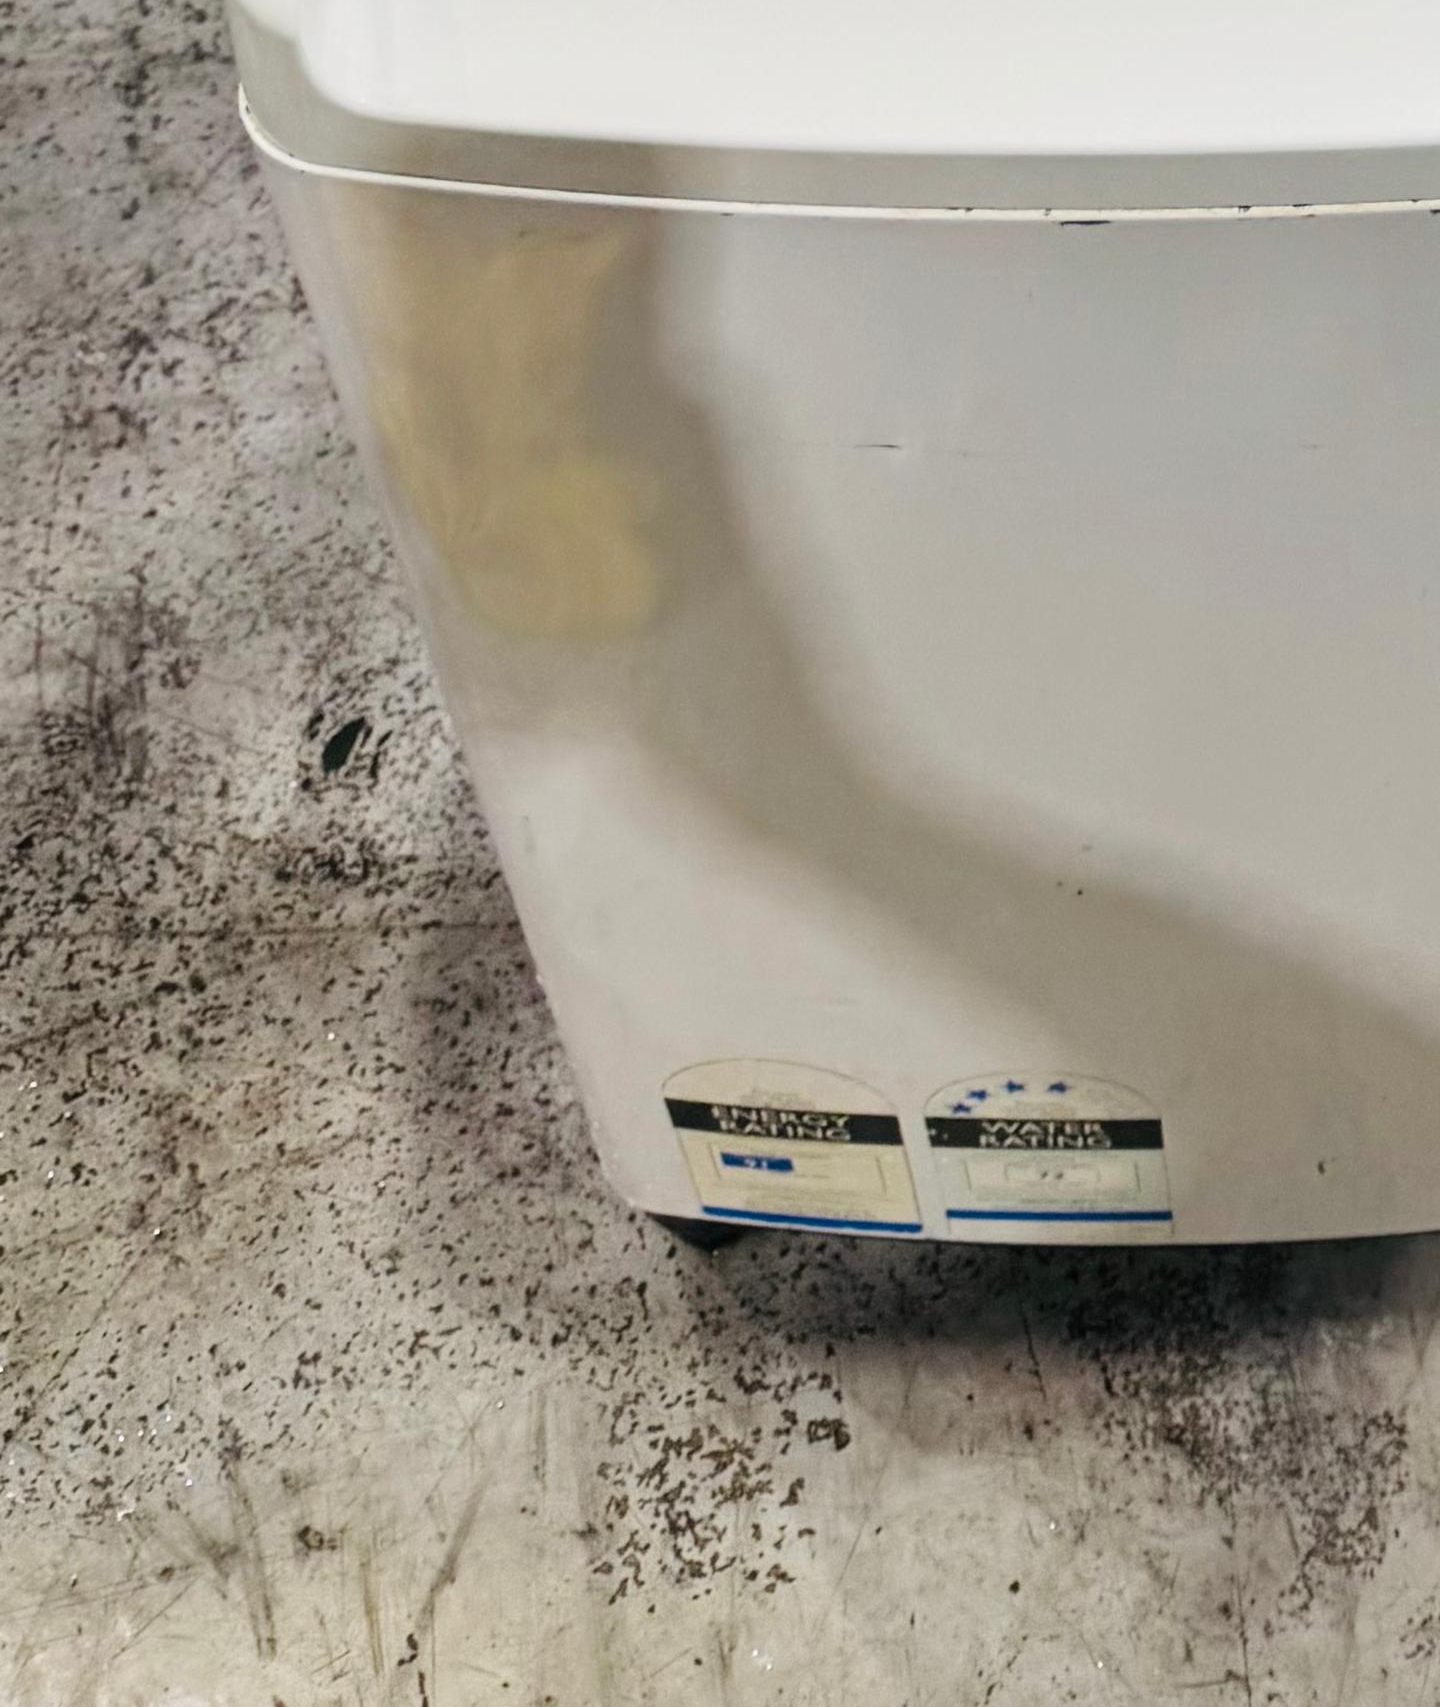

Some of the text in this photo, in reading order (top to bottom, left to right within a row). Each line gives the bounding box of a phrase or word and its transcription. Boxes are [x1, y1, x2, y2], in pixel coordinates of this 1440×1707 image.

[711, 1104, 851, 1128] ENERGY
[719, 1120, 851, 1141] RATING
[980, 1121, 1104, 1136] WATER
[978, 1134, 1113, 1150] RATING
